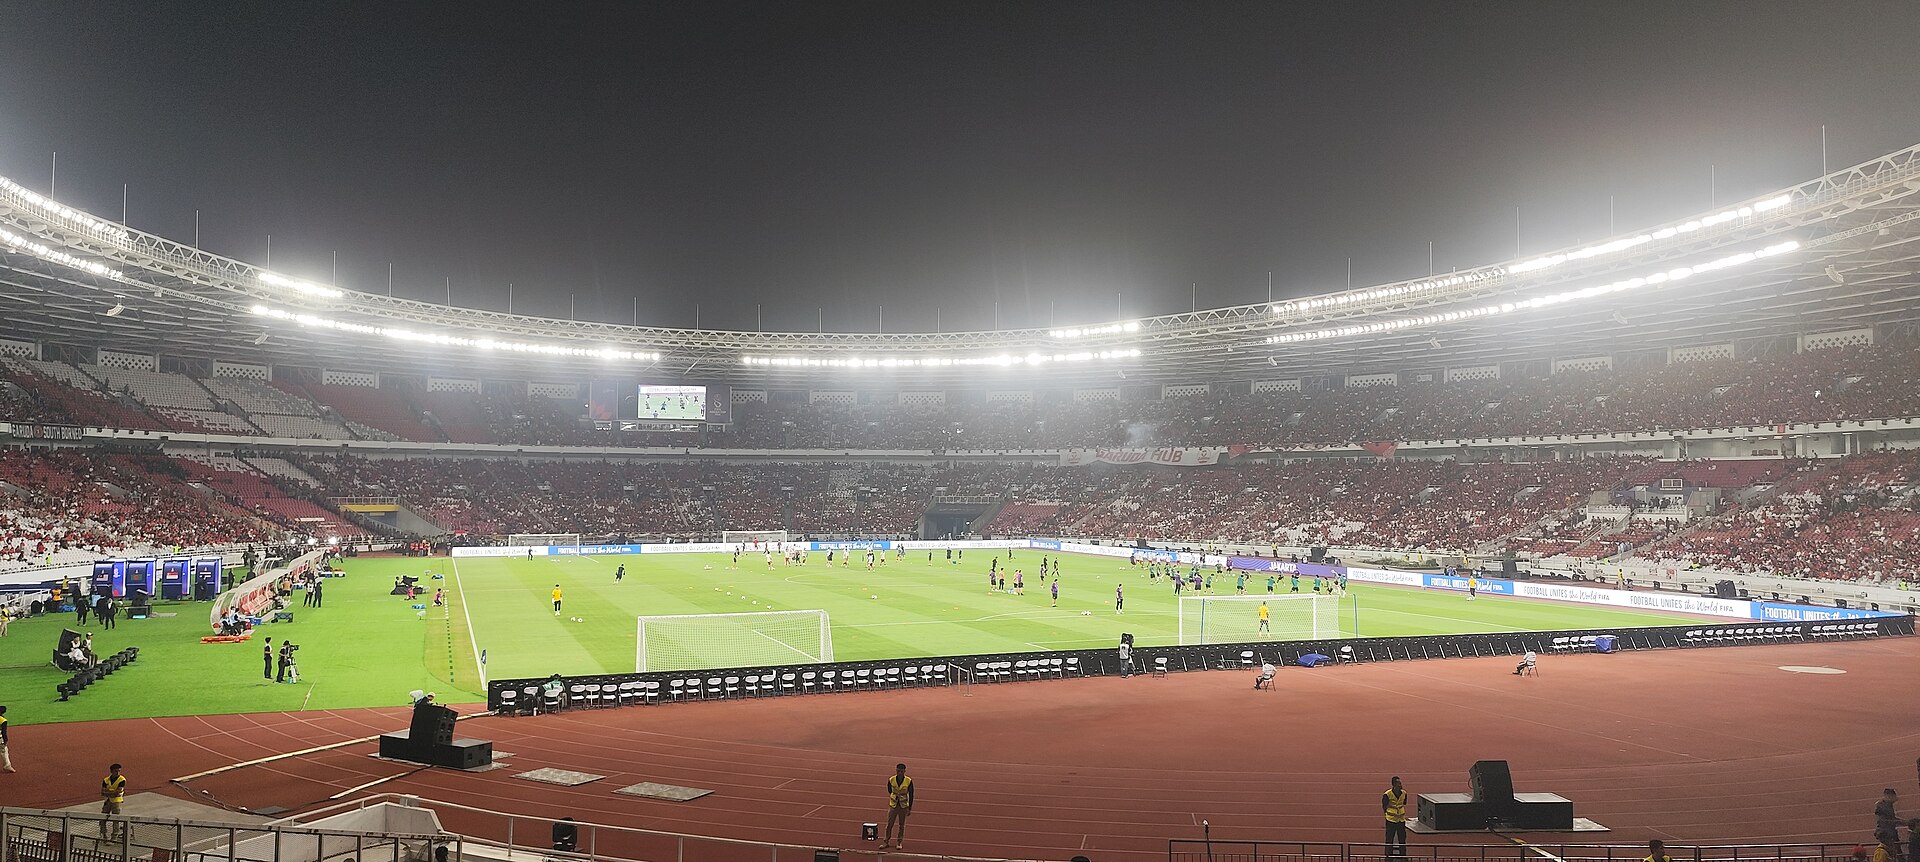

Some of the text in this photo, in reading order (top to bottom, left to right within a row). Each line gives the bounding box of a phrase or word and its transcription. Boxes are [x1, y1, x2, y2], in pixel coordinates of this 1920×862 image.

[12, 424, 82, 440] GARUDA SOUTH BORNEO
[1151, 449, 1182, 462] HUB
[1269, 562, 1297, 572] JAKARTA
[1430, 577, 1452, 588] FOOTBALL
[1452, 579, 1468, 589] UNITES
[1524, 586, 1548, 597] FOOTBALL
[1549, 588, 1568, 598] UNITES
[1569, 590, 1579, 599] the
[1579, 590, 1598, 602] World
[1630, 595, 1659, 607] FOOTBALL
[1660, 598, 1683, 609] UNITES
[1684, 599, 1696, 610] the
[1696, 600, 1718, 613] World
[1765, 607, 1801, 620] FOOTBALL
[1803, 611, 1831, 621] UNITES
